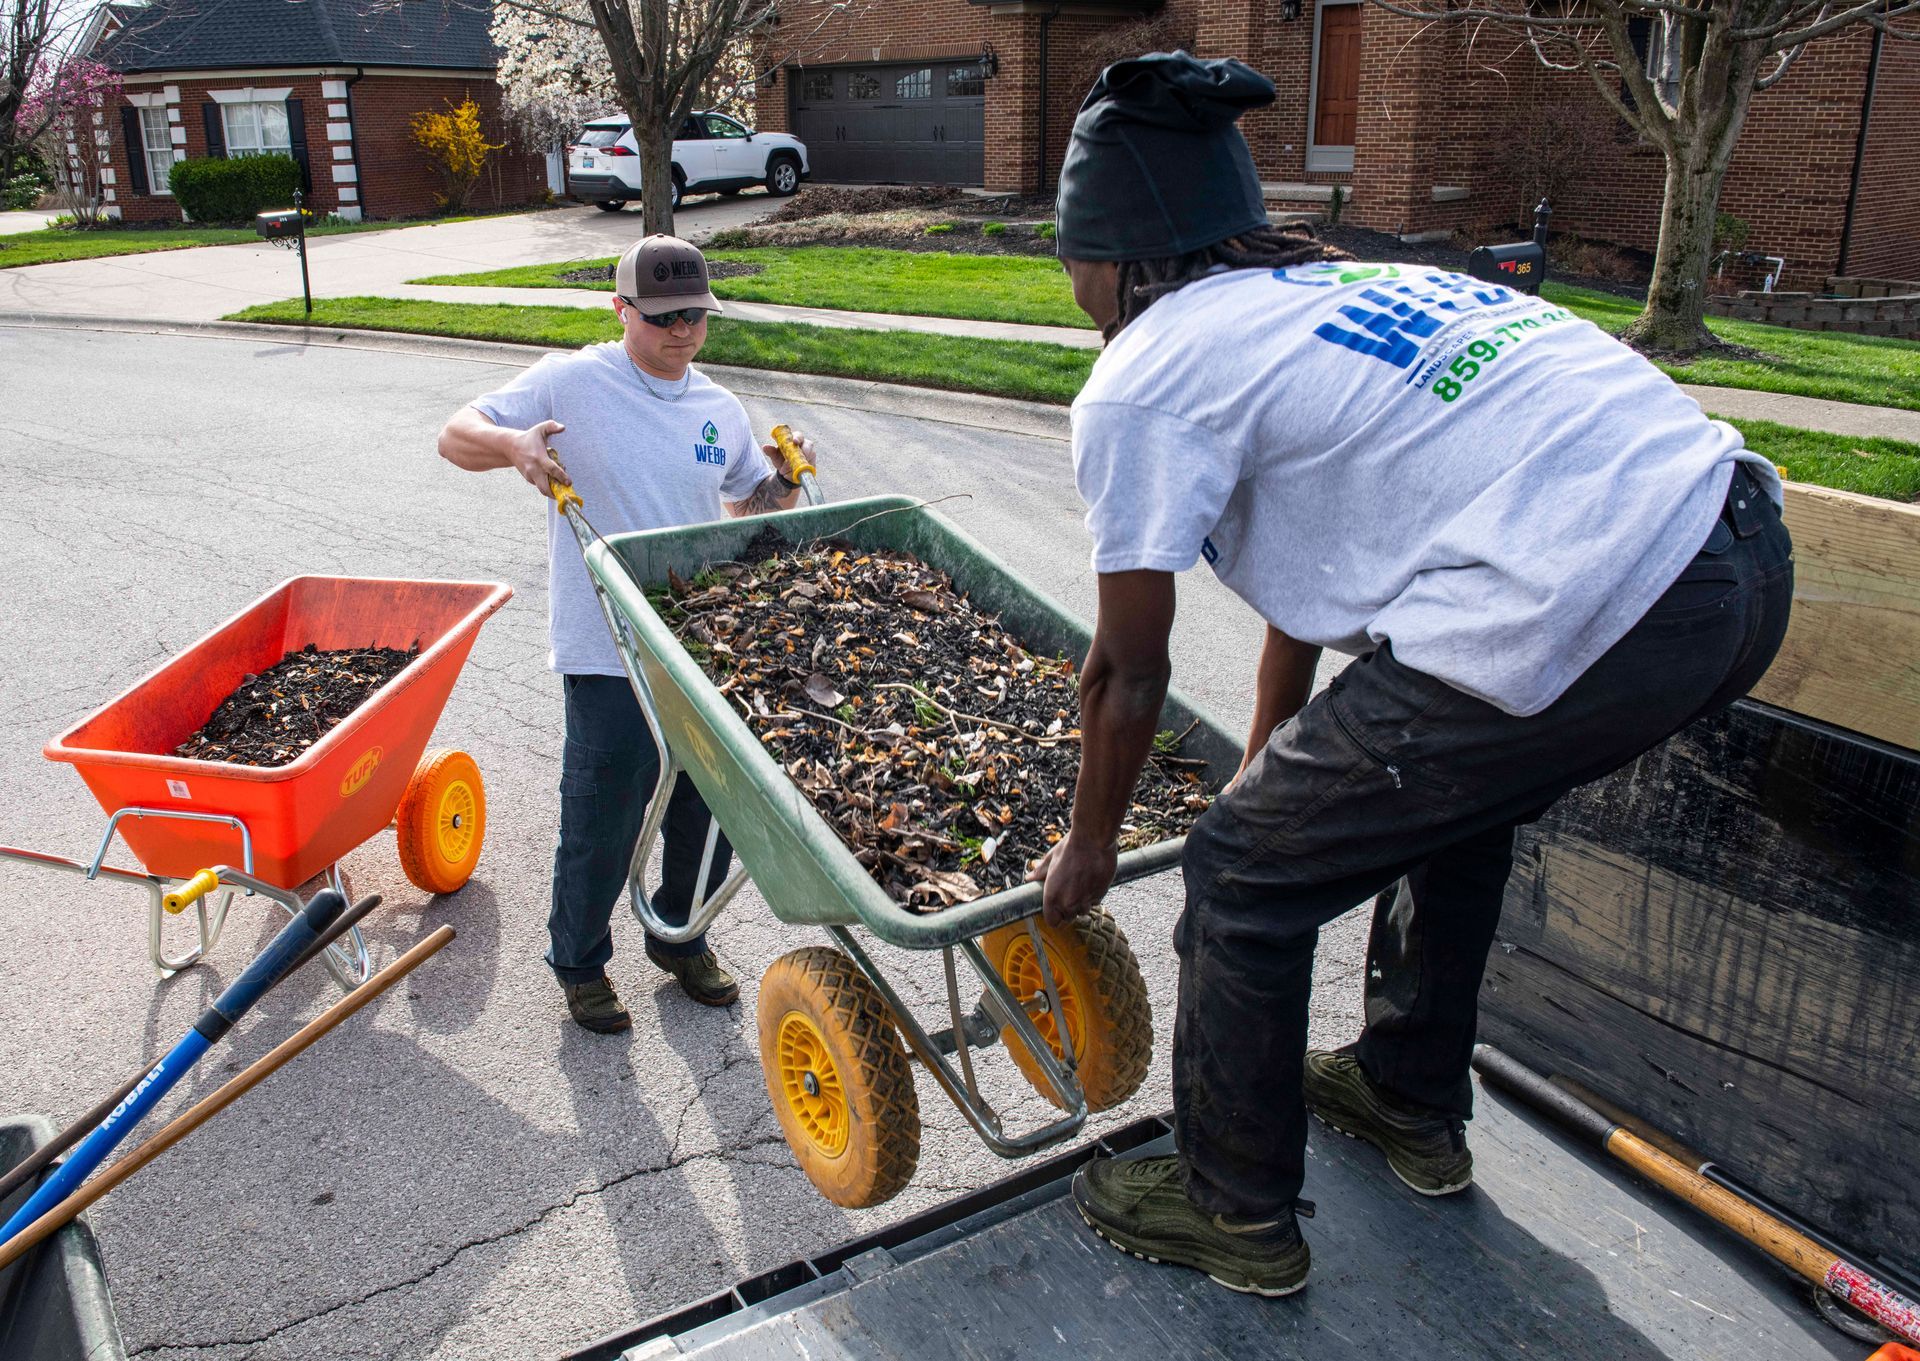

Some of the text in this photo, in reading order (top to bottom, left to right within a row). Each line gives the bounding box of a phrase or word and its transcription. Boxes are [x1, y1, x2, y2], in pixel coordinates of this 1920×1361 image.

[671, 261, 699, 276] WEBB
[1516, 262, 1532, 275] 365
[694, 443, 726, 466] WEBB
[344, 750, 381, 791] TUFX
[100, 1061, 165, 1131] KOBALT
